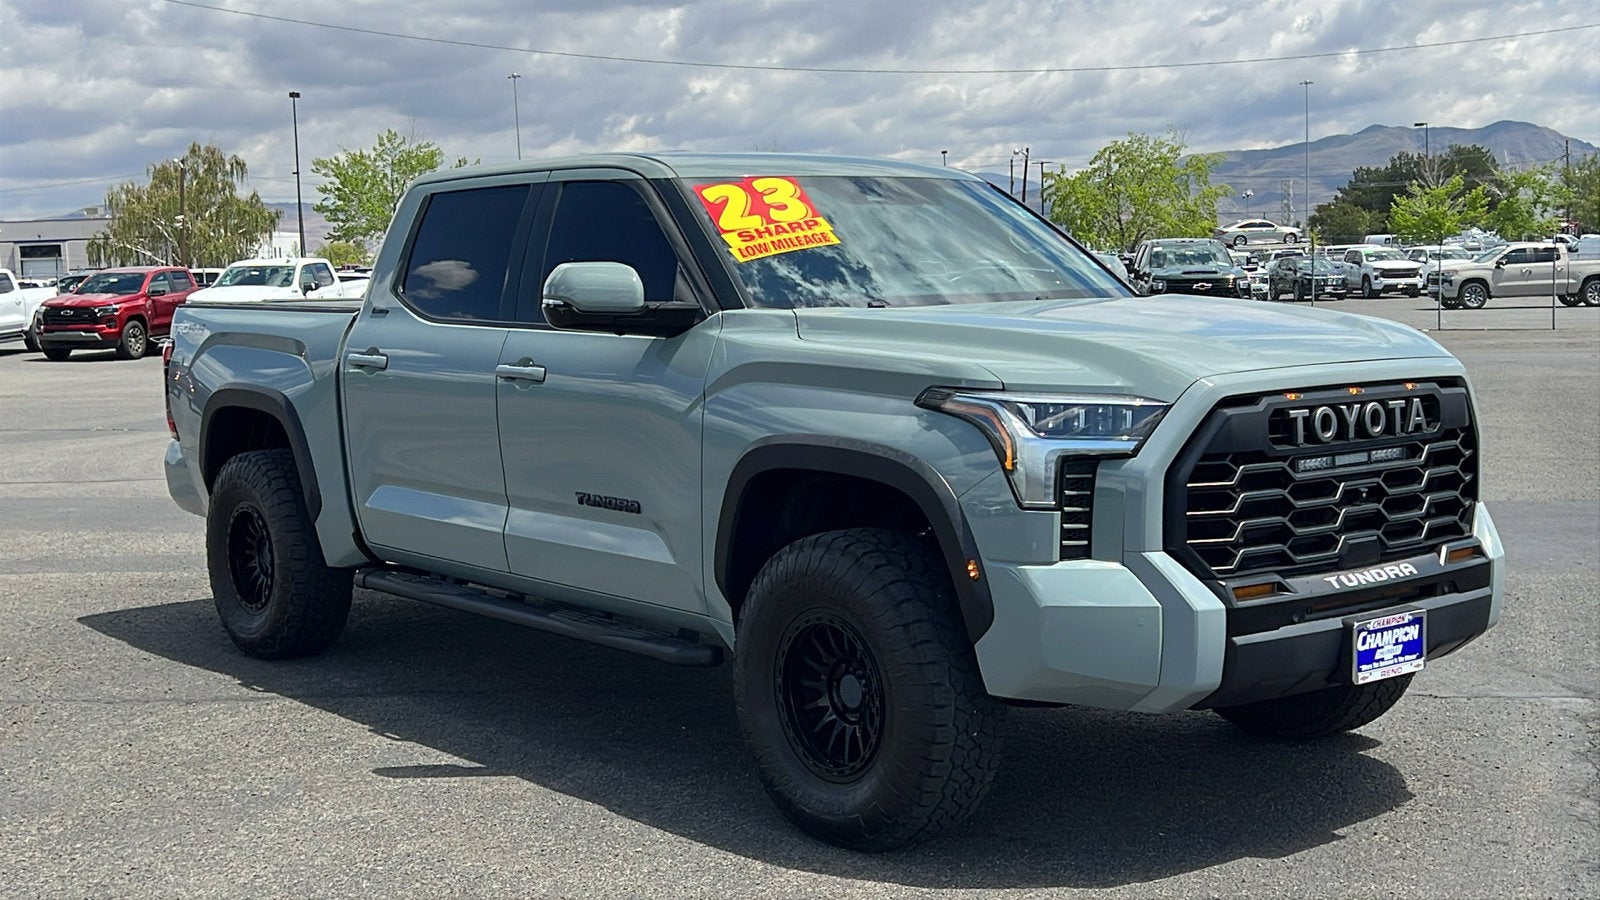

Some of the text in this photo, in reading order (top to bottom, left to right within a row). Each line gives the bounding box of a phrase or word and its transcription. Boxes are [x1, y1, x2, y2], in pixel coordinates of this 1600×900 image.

[701, 177, 811, 231] 23
[737, 219, 820, 242] SHARP
[738, 232, 832, 258] LOW MILEAGE
[1288, 398, 1428, 444] TOYOTA
[575, 491, 642, 514] TUNDRA
[1323, 562, 1418, 588] TUNDRA
[1372, 615, 1406, 628] CHAMPION
[1357, 624, 1419, 651] CHAMPION
[1380, 667, 1403, 677] RENO
